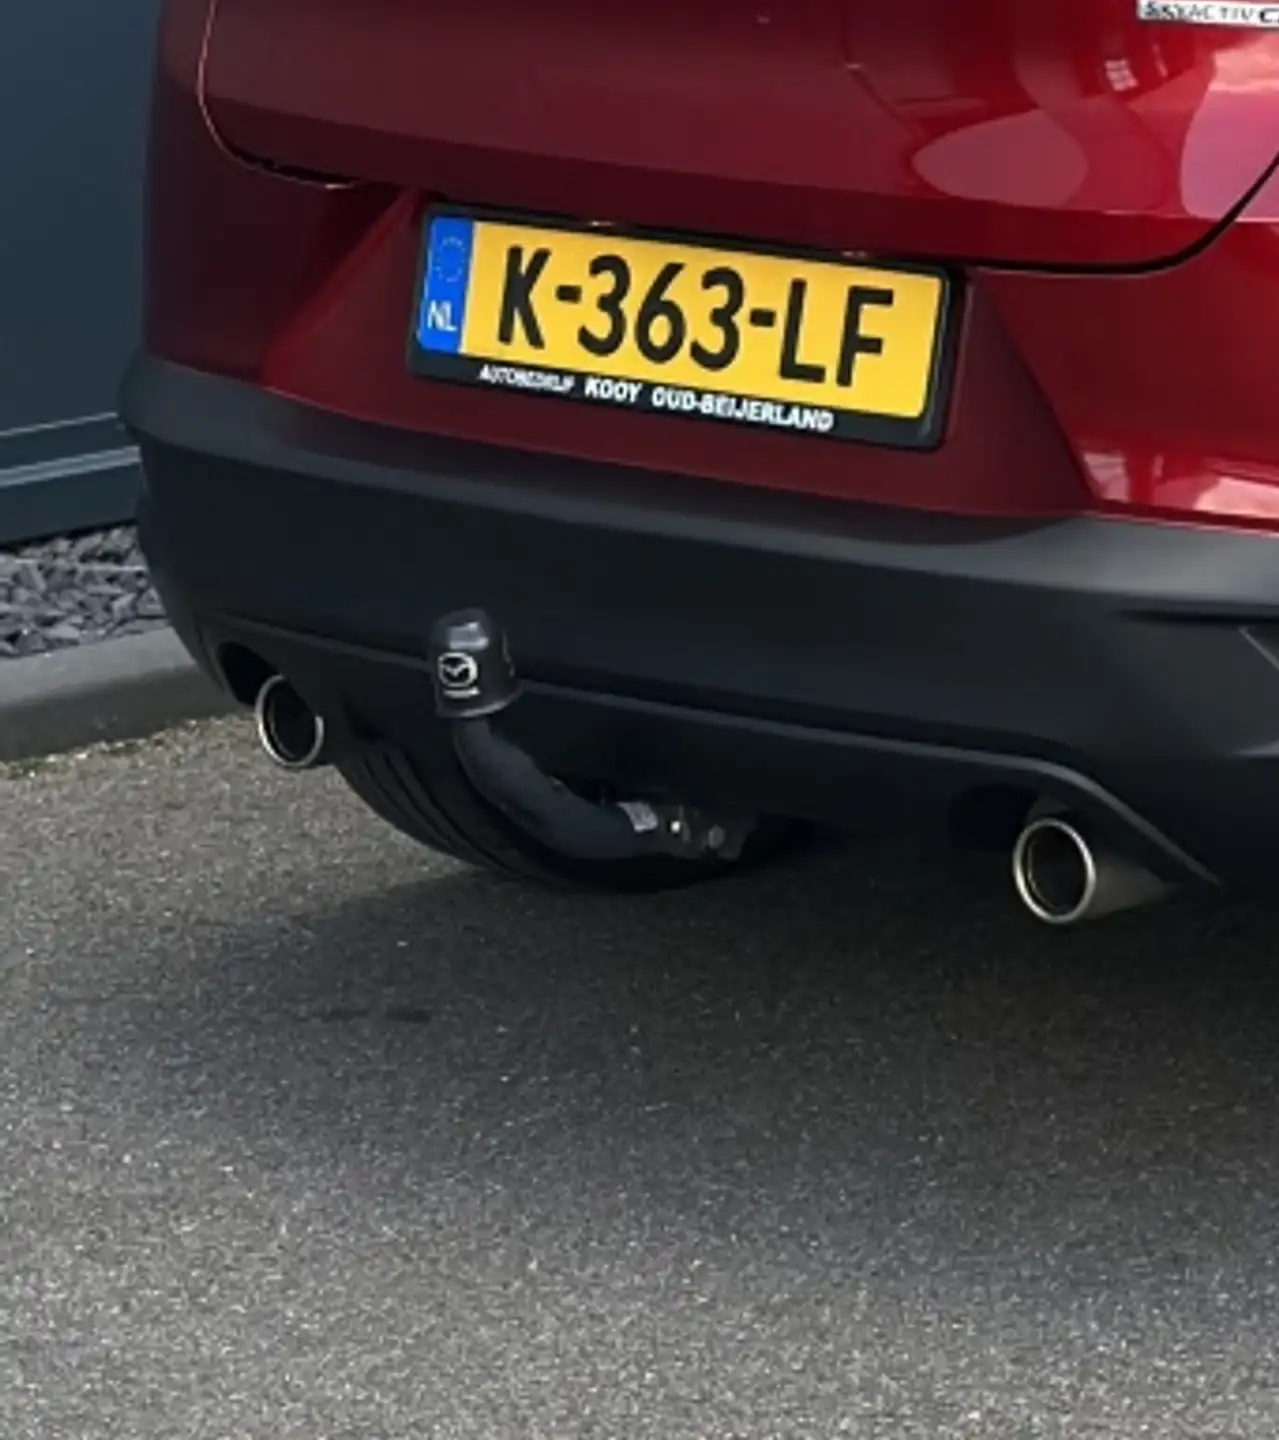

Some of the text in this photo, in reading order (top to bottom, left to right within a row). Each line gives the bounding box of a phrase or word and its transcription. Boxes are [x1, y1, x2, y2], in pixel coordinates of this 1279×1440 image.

[427, 300, 458, 332] NL
[497, 245, 894, 387] K-363-LF
[584, 376, 643, 403] KOOY
[652, 386, 835, 433] OUD-BEIJERLAND
